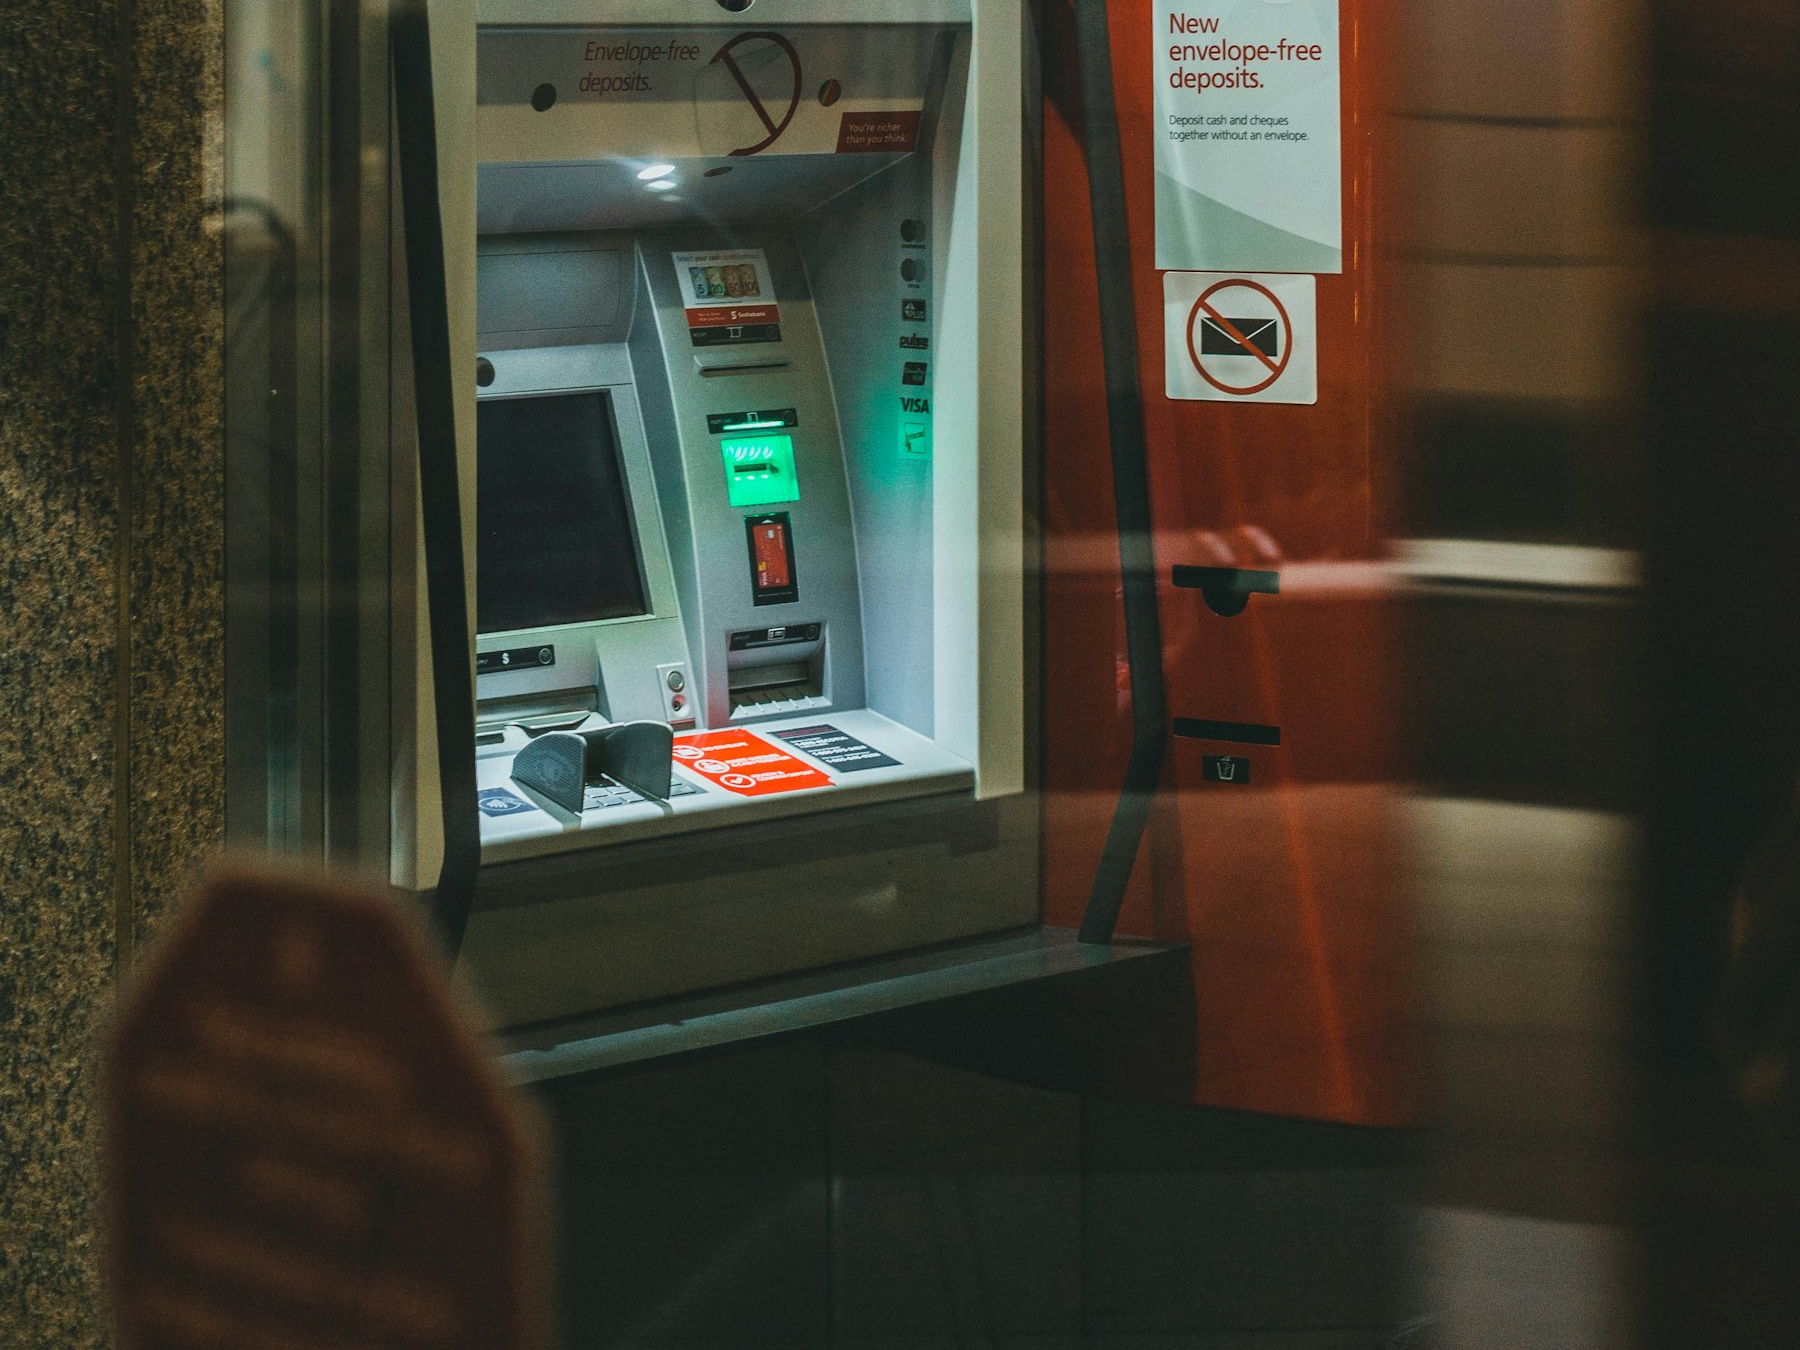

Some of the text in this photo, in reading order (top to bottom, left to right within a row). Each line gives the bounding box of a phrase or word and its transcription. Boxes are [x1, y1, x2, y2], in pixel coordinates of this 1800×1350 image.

[1169, 13, 1220, 34] New
[584, 39, 699, 64] Envelope-free
[1169, 39, 1322, 66] envelope-free
[579, 71, 653, 97] deposits.
[1169, 65, 1264, 94] deposits.
[877, 123, 902, 132] richer
[1169, 115, 1289, 128] Deposit cash and cheques
[846, 135, 865, 144] than
[867, 136, 883, 145] you
[1169, 130, 1309, 143] together without an envelope.
[900, 397, 929, 413] VISA
